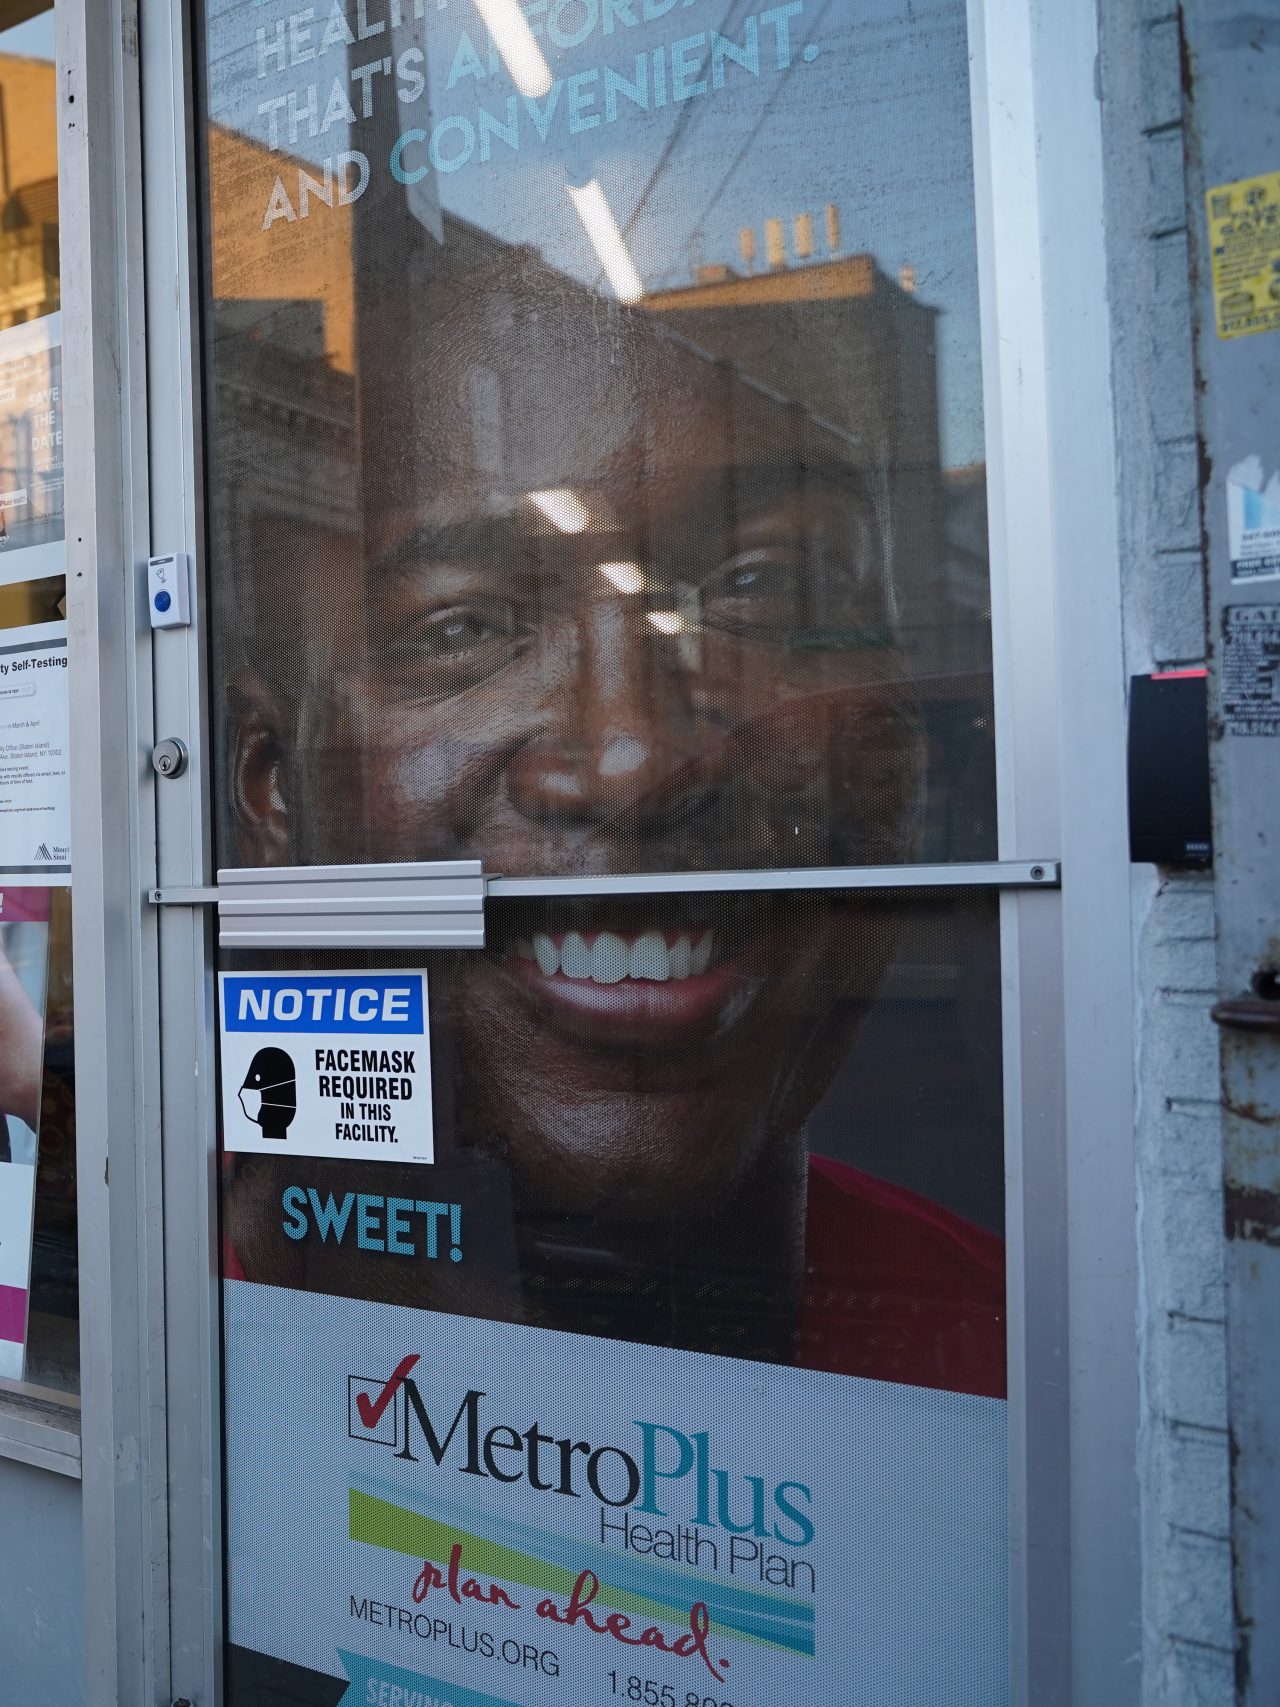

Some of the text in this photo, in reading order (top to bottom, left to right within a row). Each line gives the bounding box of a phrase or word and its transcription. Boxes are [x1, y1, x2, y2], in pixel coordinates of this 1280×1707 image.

[256, 0, 447, 79] HEAL
[258, 47, 426, 151] THAT'S
[261, 1, 821, 231] AND CONVENIENT.
[28, 386, 59, 408] SAVE
[33, 410, 56, 428] THE
[32, 431, 63, 451] DATE
[11, 656, 68, 672] Self-Testing
[238, 988, 411, 1022] NOTICE
[315, 1049, 415, 1073] FACEMASK
[319, 1075, 412, 1100] REQUIRED
[340, 1102, 391, 1121] IN THIS
[335, 1123, 399, 1143] FACILITY.
[282, 1186, 463, 1263] SWEET!
[393, 1375, 816, 1548] MetroPlus
[600, 1506, 816, 1593] Health Plan
[412, 1543, 730, 1684] plan ahead.
[349, 1595, 734, 1707] METROPLUS.ORG 1.855.8
